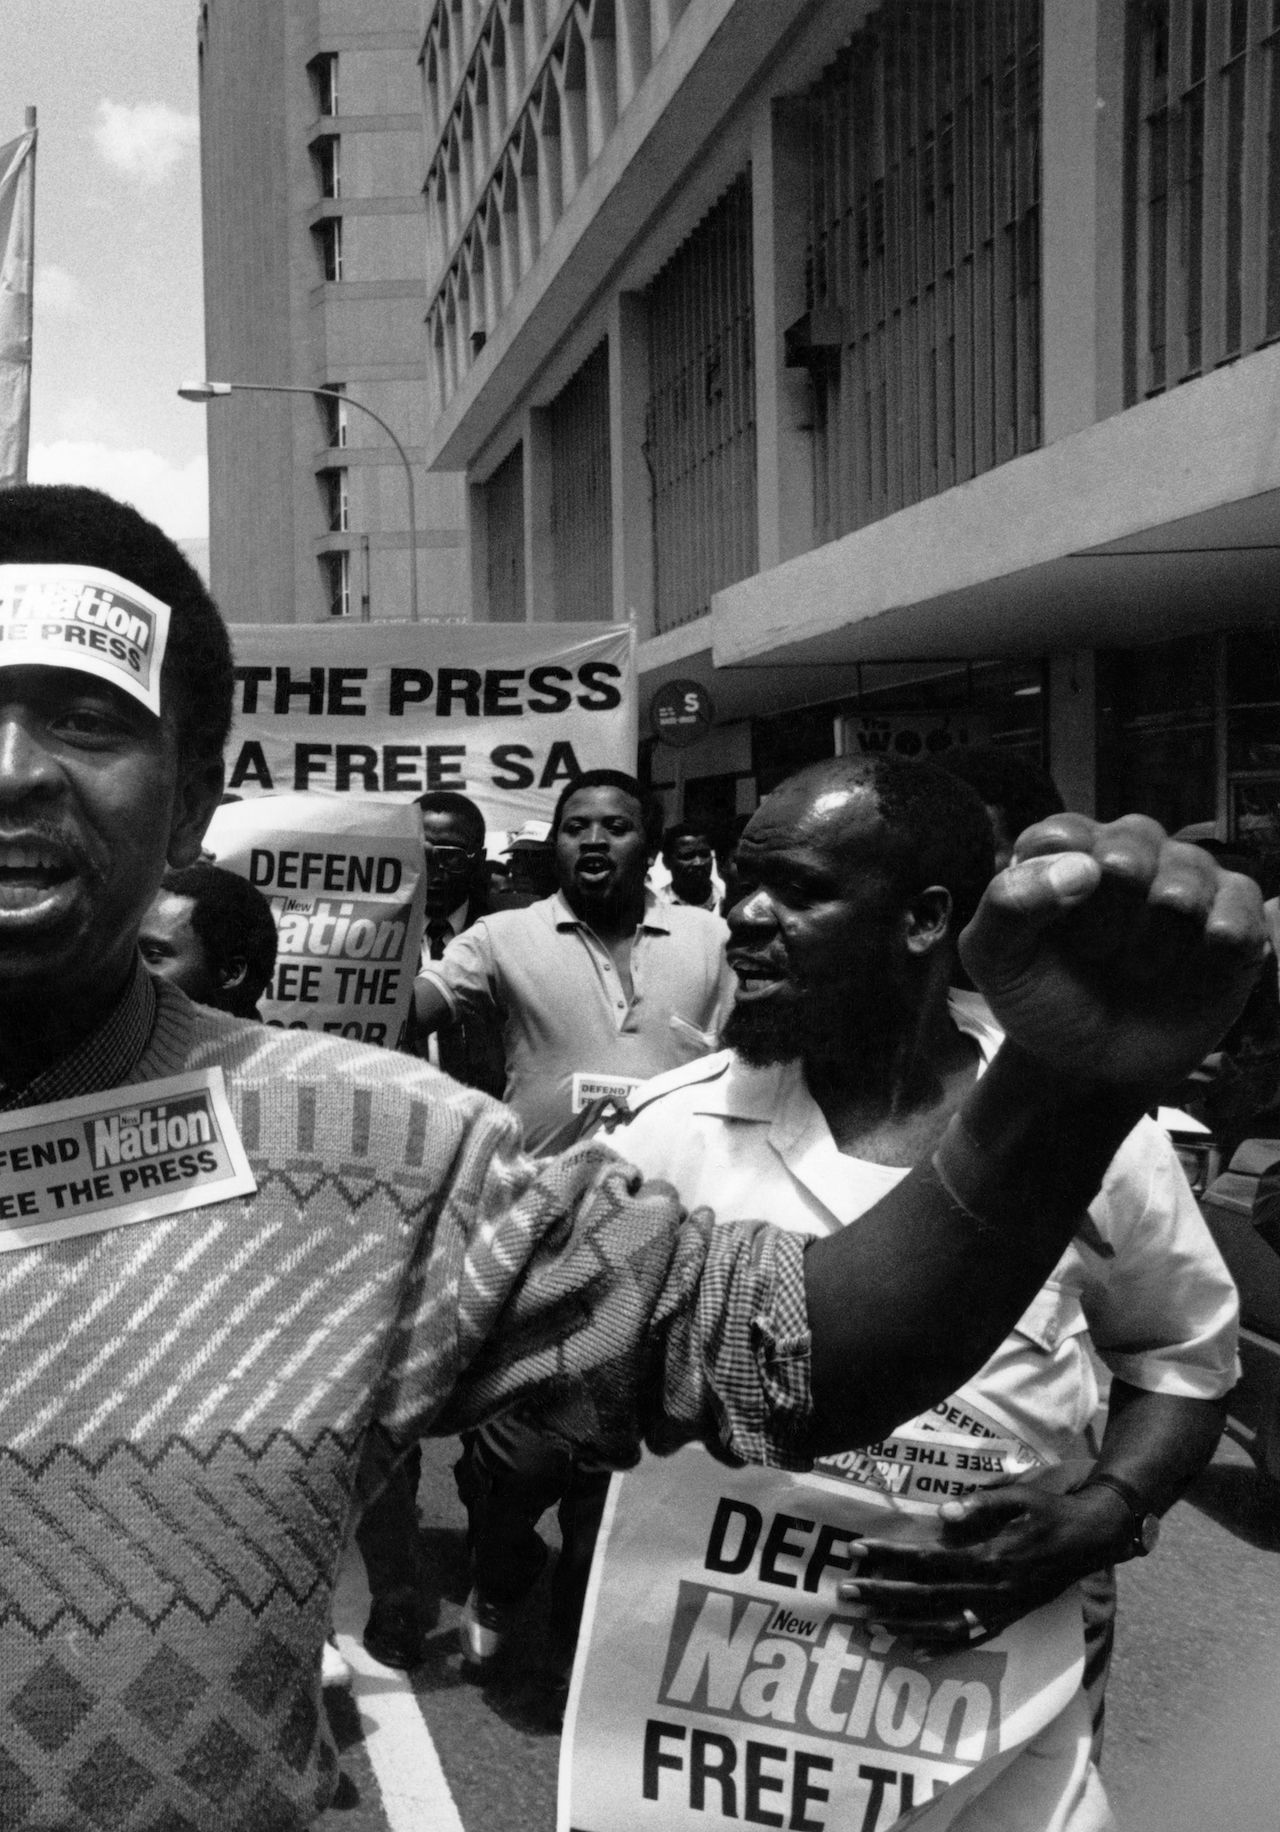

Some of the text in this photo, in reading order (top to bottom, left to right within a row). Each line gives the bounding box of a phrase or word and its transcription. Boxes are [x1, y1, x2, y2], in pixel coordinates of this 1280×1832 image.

[40, 623, 141, 673] PRESS
[233, 661, 622, 718] THE PRESS
[684, 692, 700, 713] S
[227, 740, 584, 792] A FREE SA
[248, 848, 403, 895] DEFEND
[271, 897, 406, 960] ation
[286, 899, 312, 913] New
[334, 966, 401, 1005] THE
[581, 1084, 626, 1095] DEFEND
[92, 1105, 211, 1170] Nation
[120, 1114, 139, 1128] New
[46, 1174, 114, 1211] THE
[119, 1149, 219, 1194] PRESS
[932, 1401, 1002, 1440] DEFEN
[904, 1446, 949, 1467] THE
[955, 1452, 1005, 1474] FREE
[704, 1496, 866, 1596] DEF
[771, 1607, 819, 1640] New
[666, 1590, 994, 1762] Nation
[643, 1718, 835, 1832] FREE
